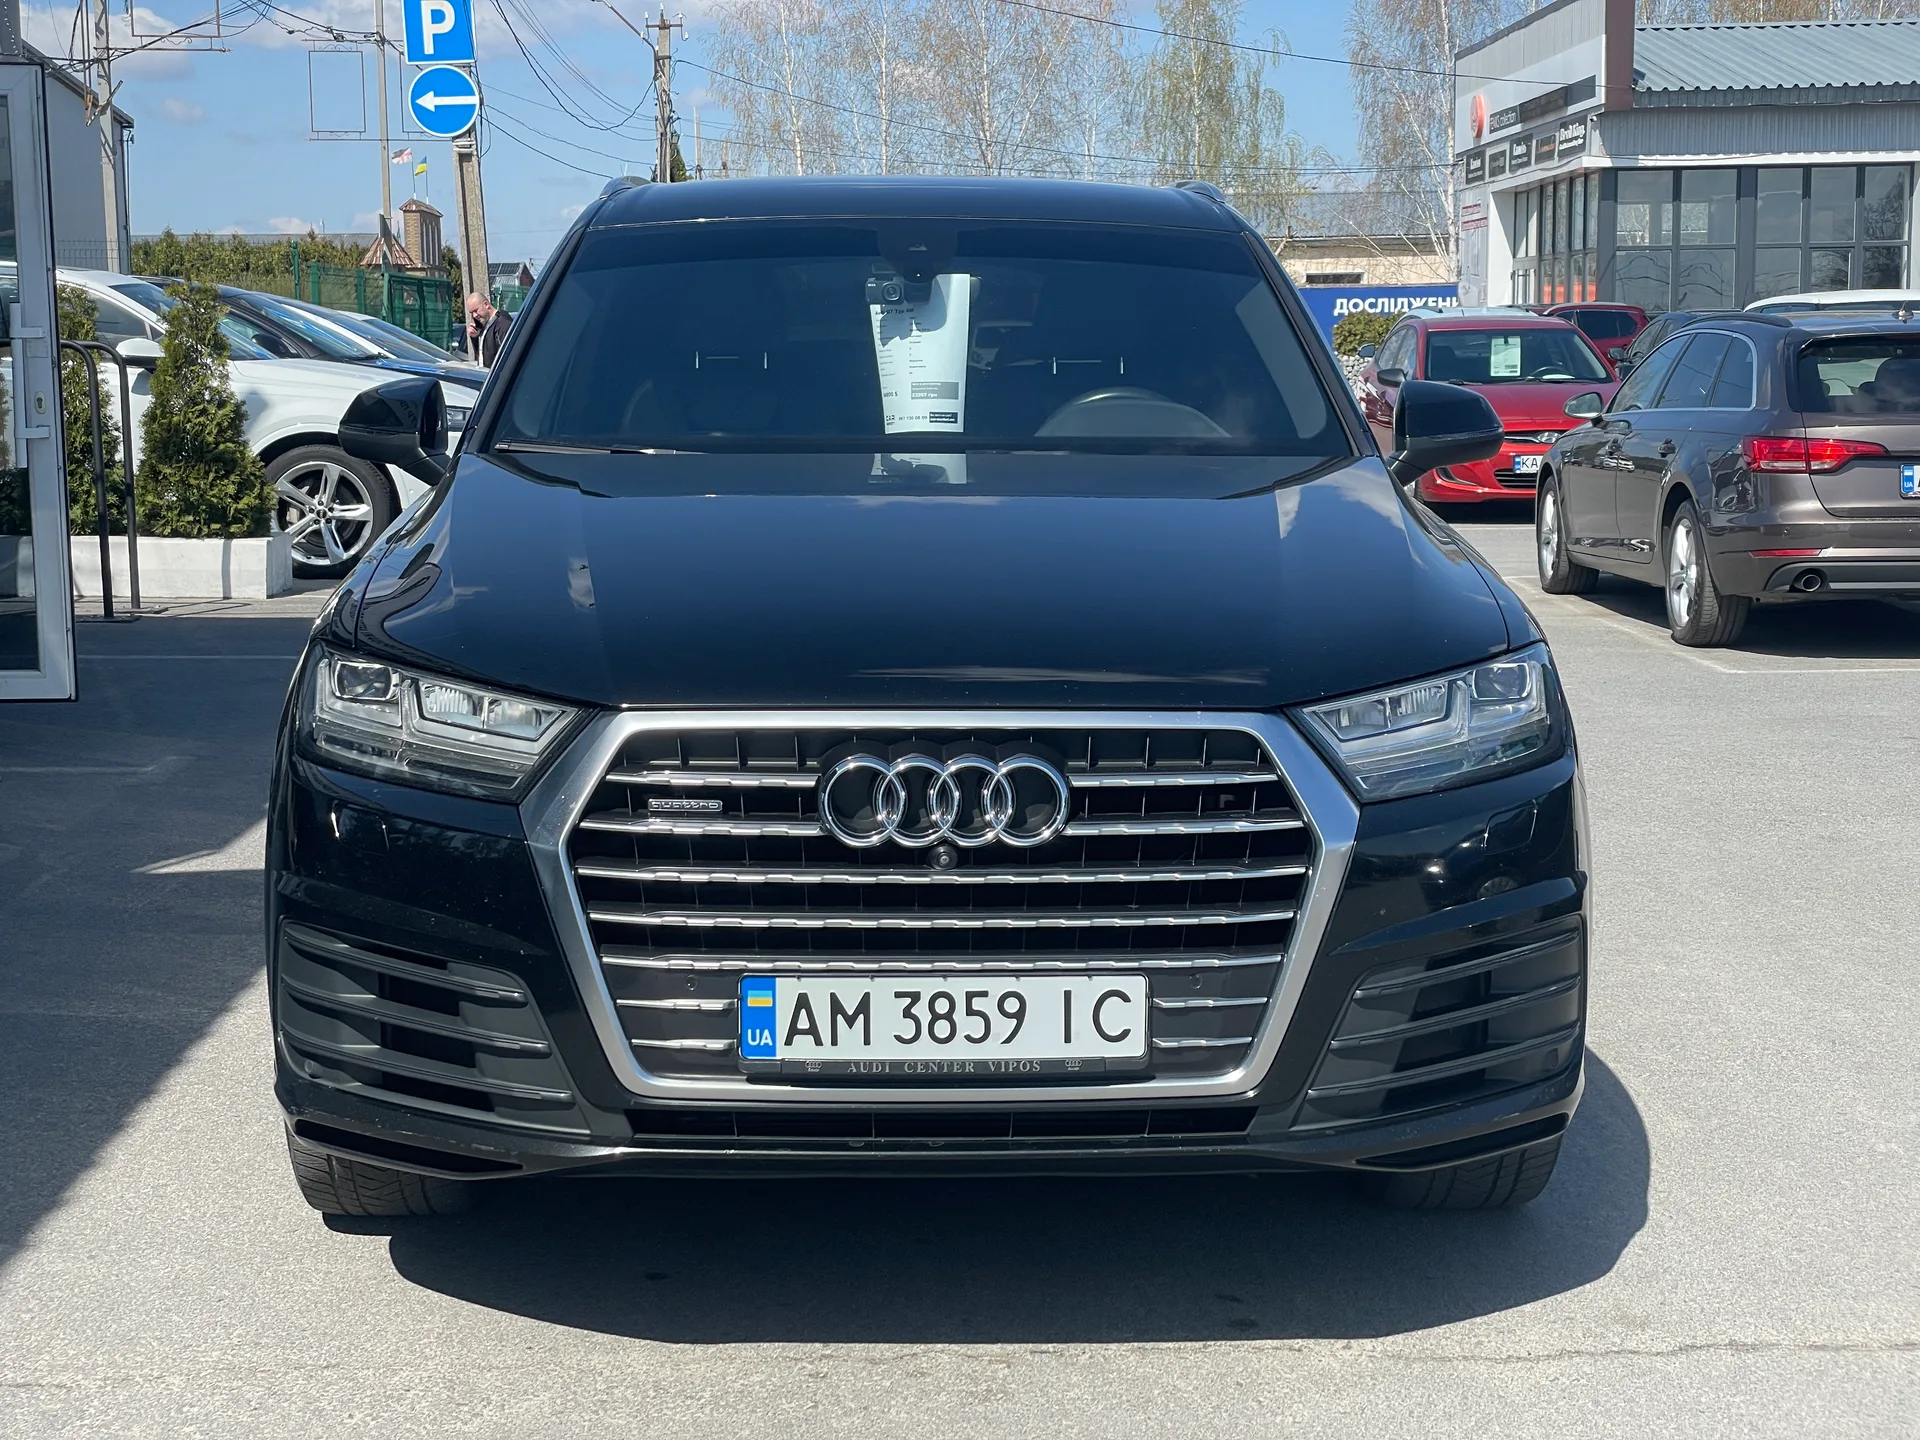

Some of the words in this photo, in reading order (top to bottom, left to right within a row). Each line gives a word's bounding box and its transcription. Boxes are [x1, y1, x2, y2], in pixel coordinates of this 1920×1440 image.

[421, 0, 456, 55] P
[1521, 457, 1539, 469] KA
[651, 801, 719, 809] quattro
[784, 991, 871, 1047] AM
[893, 989, 1028, 1045] 3859
[1063, 988, 1132, 1044] IC
[747, 1029, 773, 1046] UA
[847, 1061, 890, 1073] AUDI
[904, 1060, 975, 1073] CENTER
[988, 1060, 1041, 1072] VIPOS
